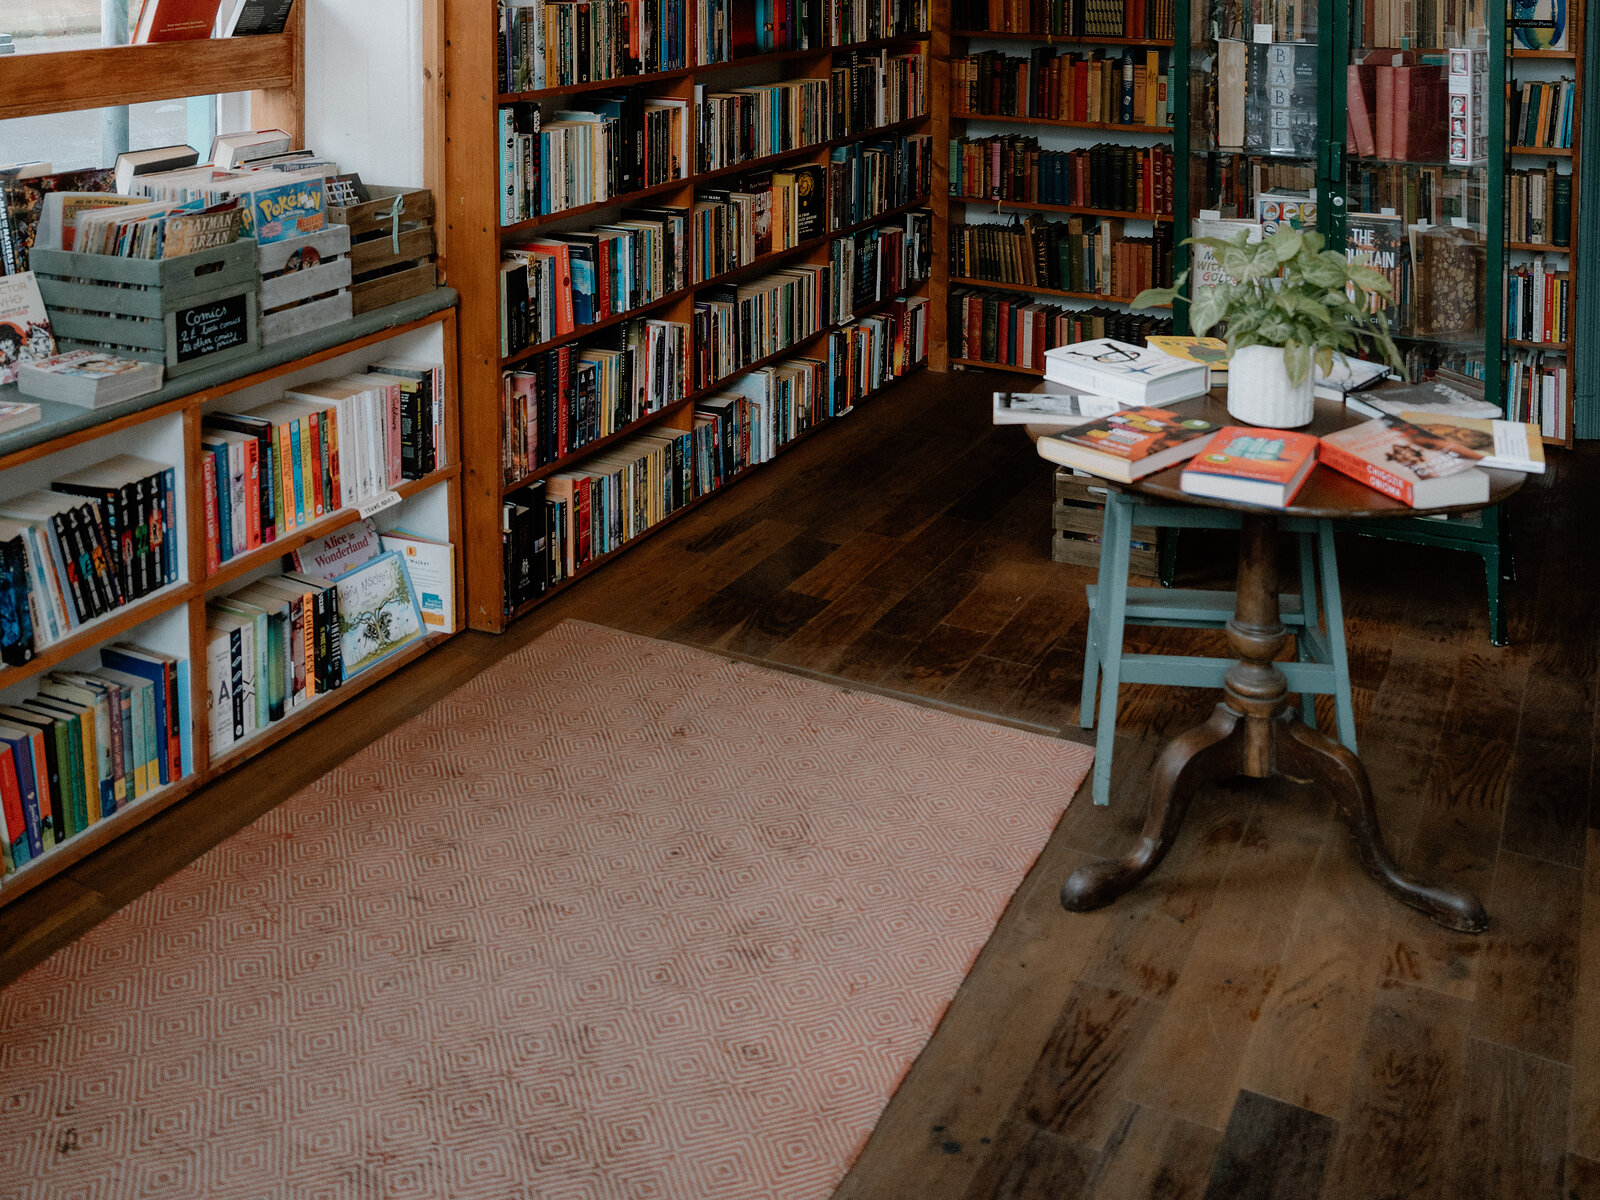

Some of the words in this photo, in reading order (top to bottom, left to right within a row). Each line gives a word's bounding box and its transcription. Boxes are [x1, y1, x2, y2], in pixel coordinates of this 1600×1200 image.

[1276, 48, 1286, 146] BABEL
[187, 212, 234, 232] BATMAN
[185, 230, 230, 249] TARZAN
[1351, 228, 1375, 247] THE
[1038, 241, 1046, 277] SWIFT
[1346, 248, 1395, 269] OUNTAIN
[185, 306, 227, 326] Comics
[249, 442, 257, 463] FEAR
[1366, 463, 1404, 488] CHIGOZIE
[1369, 476, 1401, 498] OBIOMA
[364, 503, 380, 514] YOUNG
[380, 495, 395, 506] ADULT
[322, 532, 348, 551] Alice
[348, 531, 356, 540] in
[314, 536, 369, 568] Wonderland
[305, 609, 313, 651] CONCRETE
[331, 623, 340, 662] INFINITE
